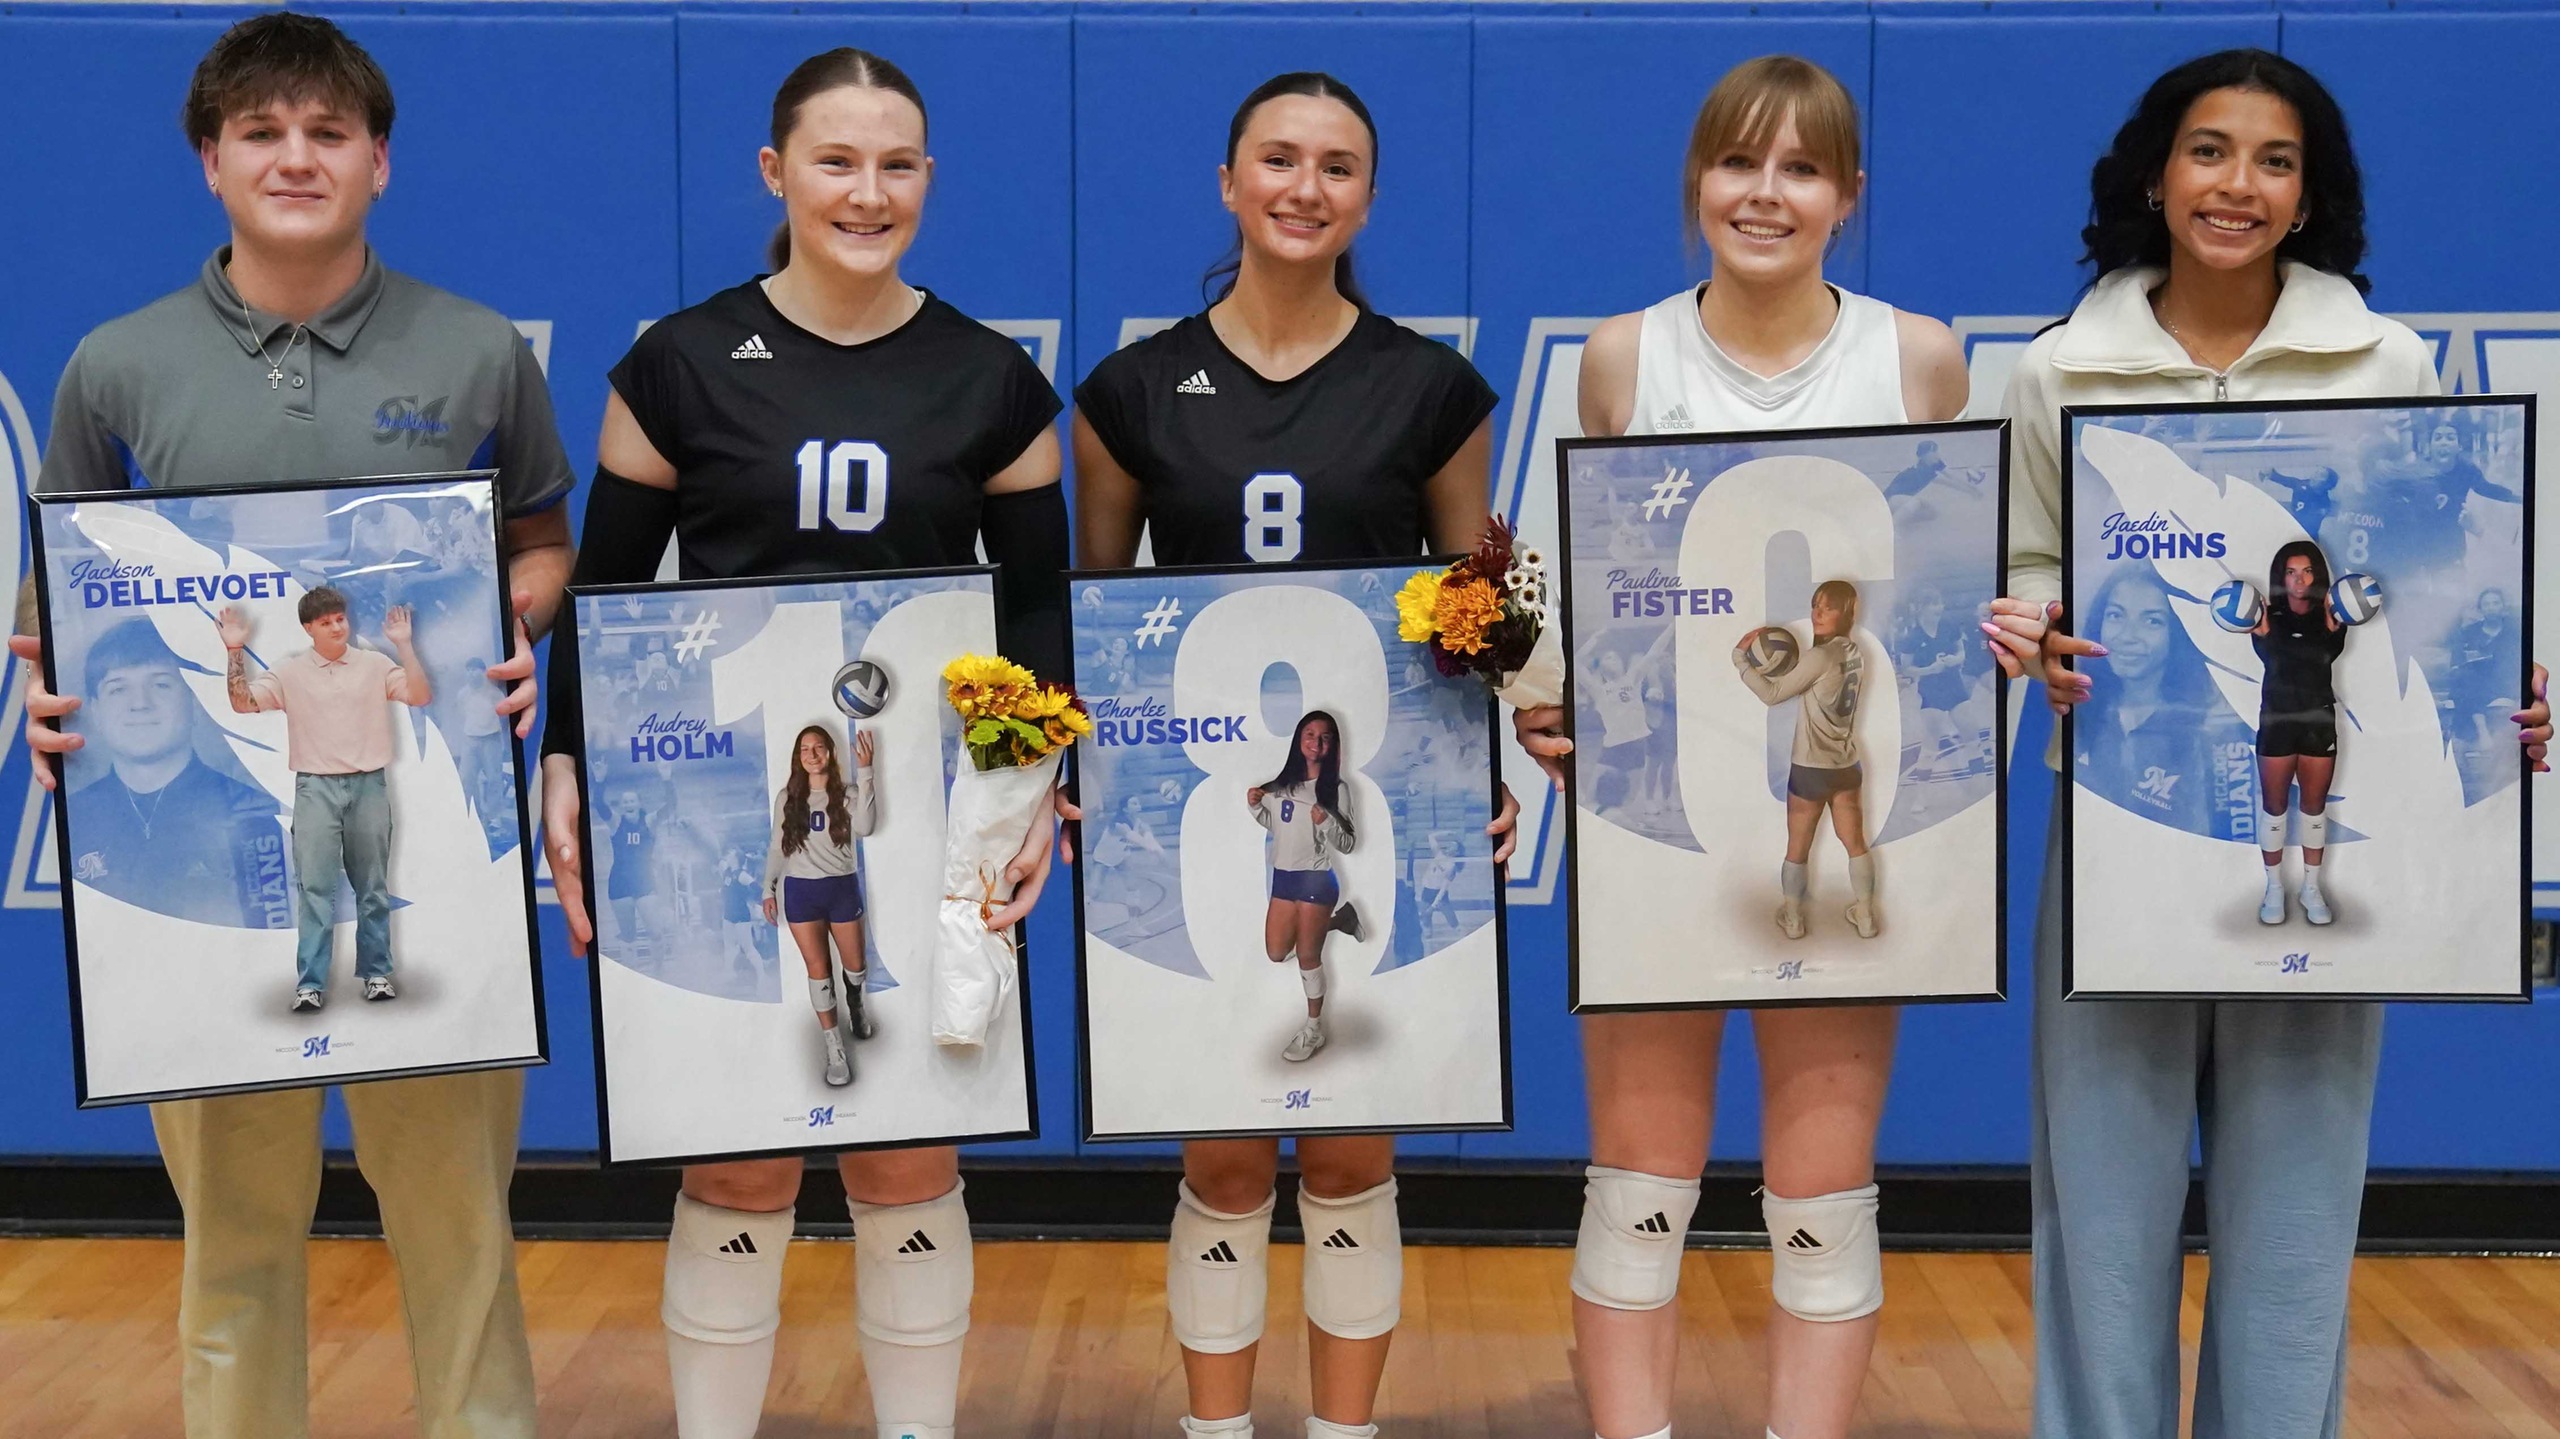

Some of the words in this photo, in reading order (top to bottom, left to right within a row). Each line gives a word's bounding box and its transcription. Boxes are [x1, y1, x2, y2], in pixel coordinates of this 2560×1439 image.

[731, 348, 774, 360] adidas
[1176, 383, 1217, 395] adidas
[1654, 420, 1696, 431] adidas
[795, 439, 890, 534] 10
[1242, 472, 1304, 563] 8
[2101, 511, 2169, 540] Jaedin
[2106, 532, 2227, 560] JOHNS
[2346, 529, 2370, 565] 8
[70, 558, 156, 589] Jackson
[1606, 567, 1683, 590] Paulina
[83, 571, 292, 609] DELLEVOET
[1612, 588, 1735, 618] FISTER
[1096, 696, 1167, 718] Charlee
[637, 710, 708, 739] Audrey
[1097, 716, 1249, 747] RUSSICK
[630, 731, 734, 763] HOLM
[1281, 799, 1295, 823] 8
[626, 832, 640, 845] 10
